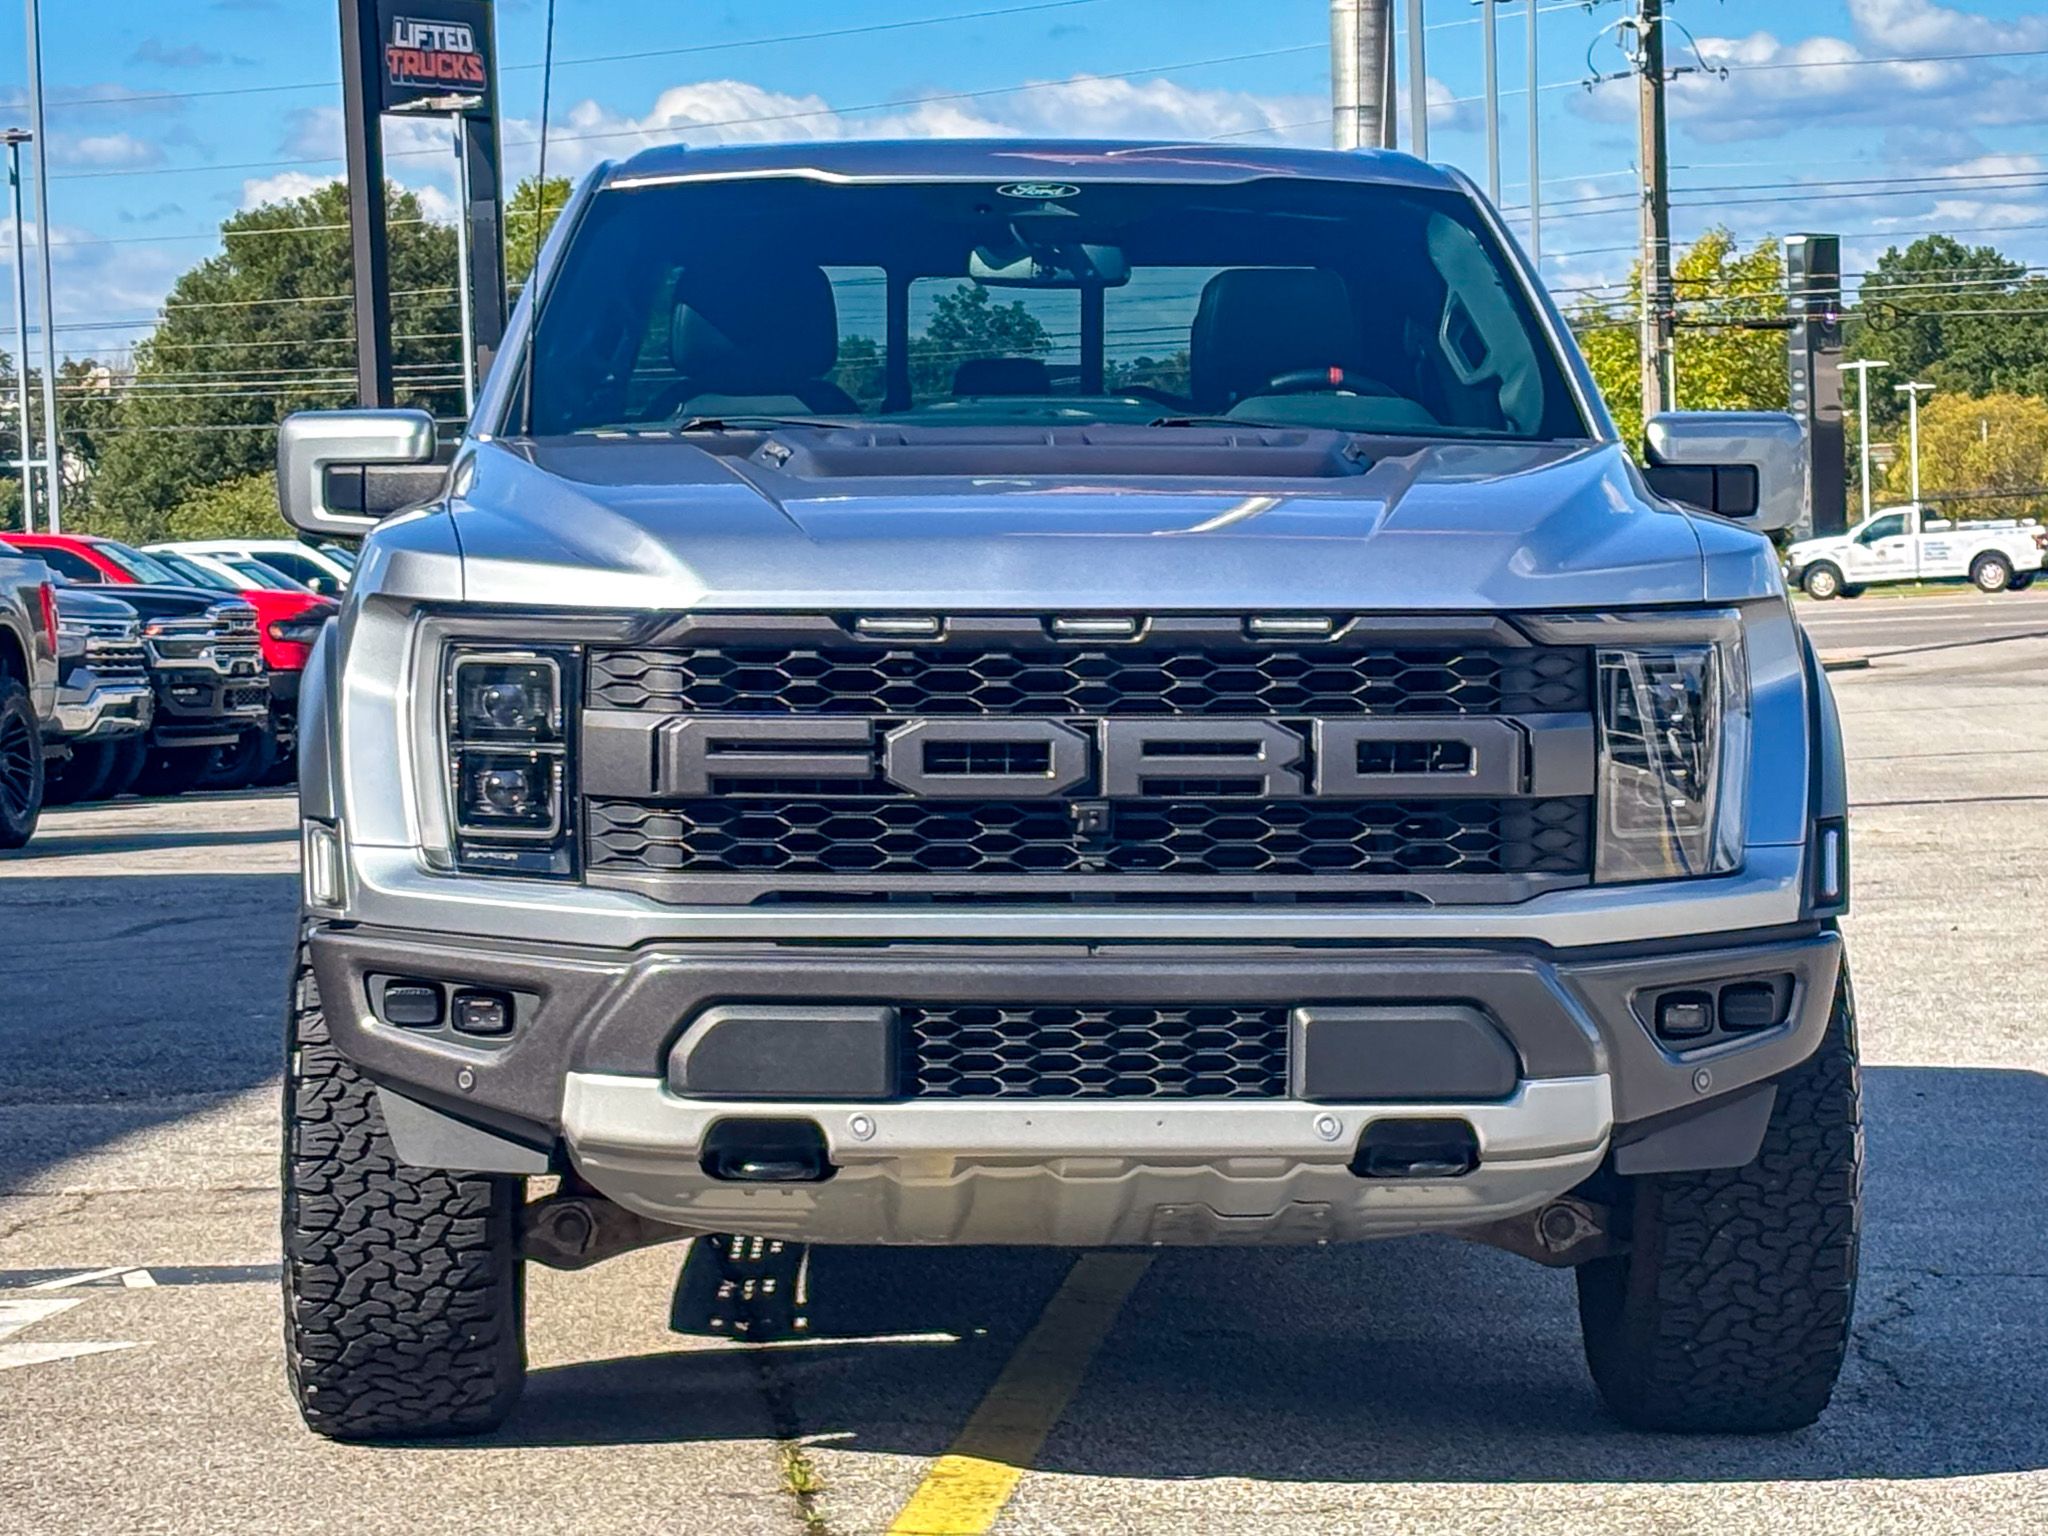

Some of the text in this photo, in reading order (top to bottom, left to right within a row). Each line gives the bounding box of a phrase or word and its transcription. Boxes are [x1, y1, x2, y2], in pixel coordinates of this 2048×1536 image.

[394, 22, 473, 53] LIFTED
[388, 50, 483, 82] TRUCKS
[1011, 184, 1065, 196] Ford
[660, 719, 1520, 796] FORD
